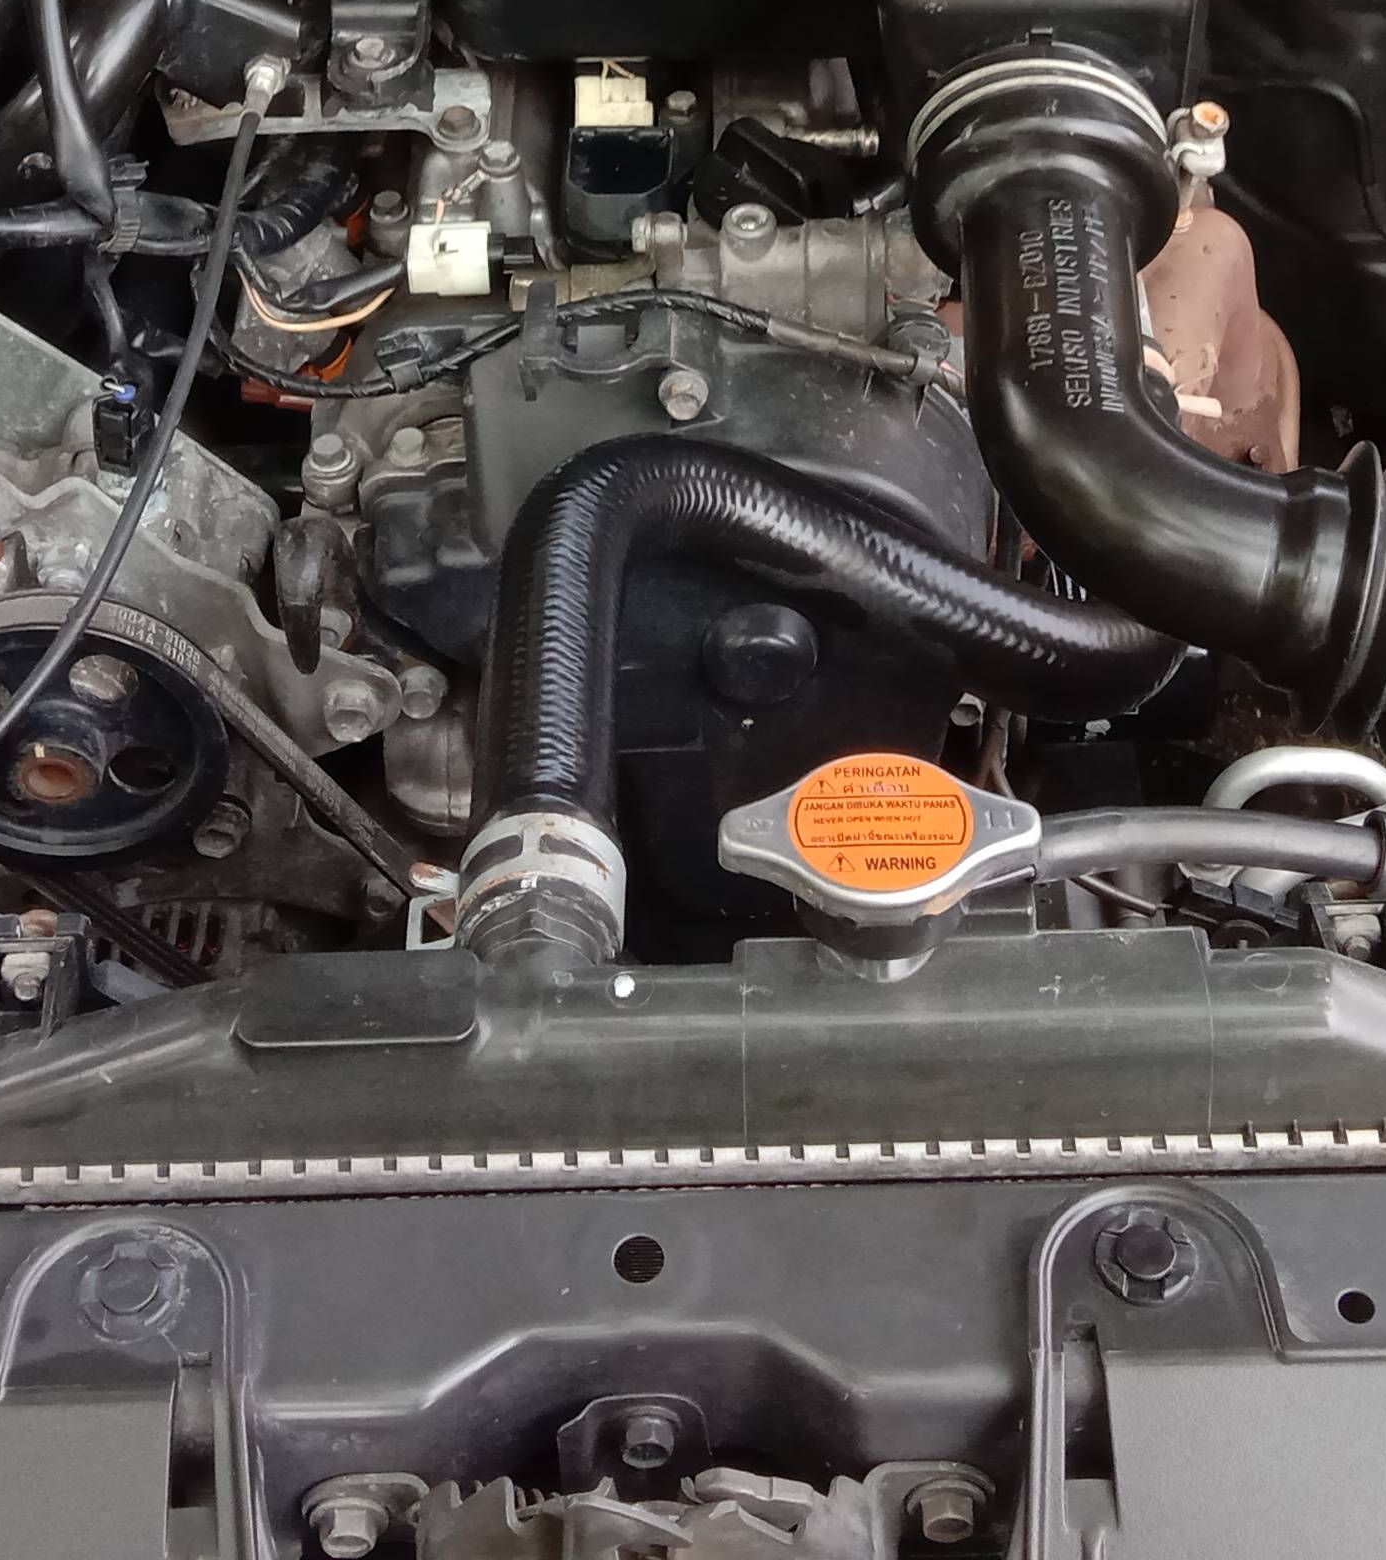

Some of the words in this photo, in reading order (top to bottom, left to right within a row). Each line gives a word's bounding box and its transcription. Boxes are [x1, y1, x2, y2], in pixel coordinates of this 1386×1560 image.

[1048, 199, 1084, 317] INDUSTRIES
[1060, 328, 1092, 408] SEKISO
[834, 766, 921, 778] PERINGATAN
[803, 801, 844, 811] JANGAN
[846, 800, 884, 810] DIBUKA
[885, 800, 921, 809] WAKTU
[923, 800, 956, 809] PANAS
[813, 816, 844, 825] NEVER
[846, 816, 871, 824] OPEN
[873, 815, 901, 823] WHEN
[903, 815, 922, 823] HOT
[865, 856, 937, 871] WARNING
